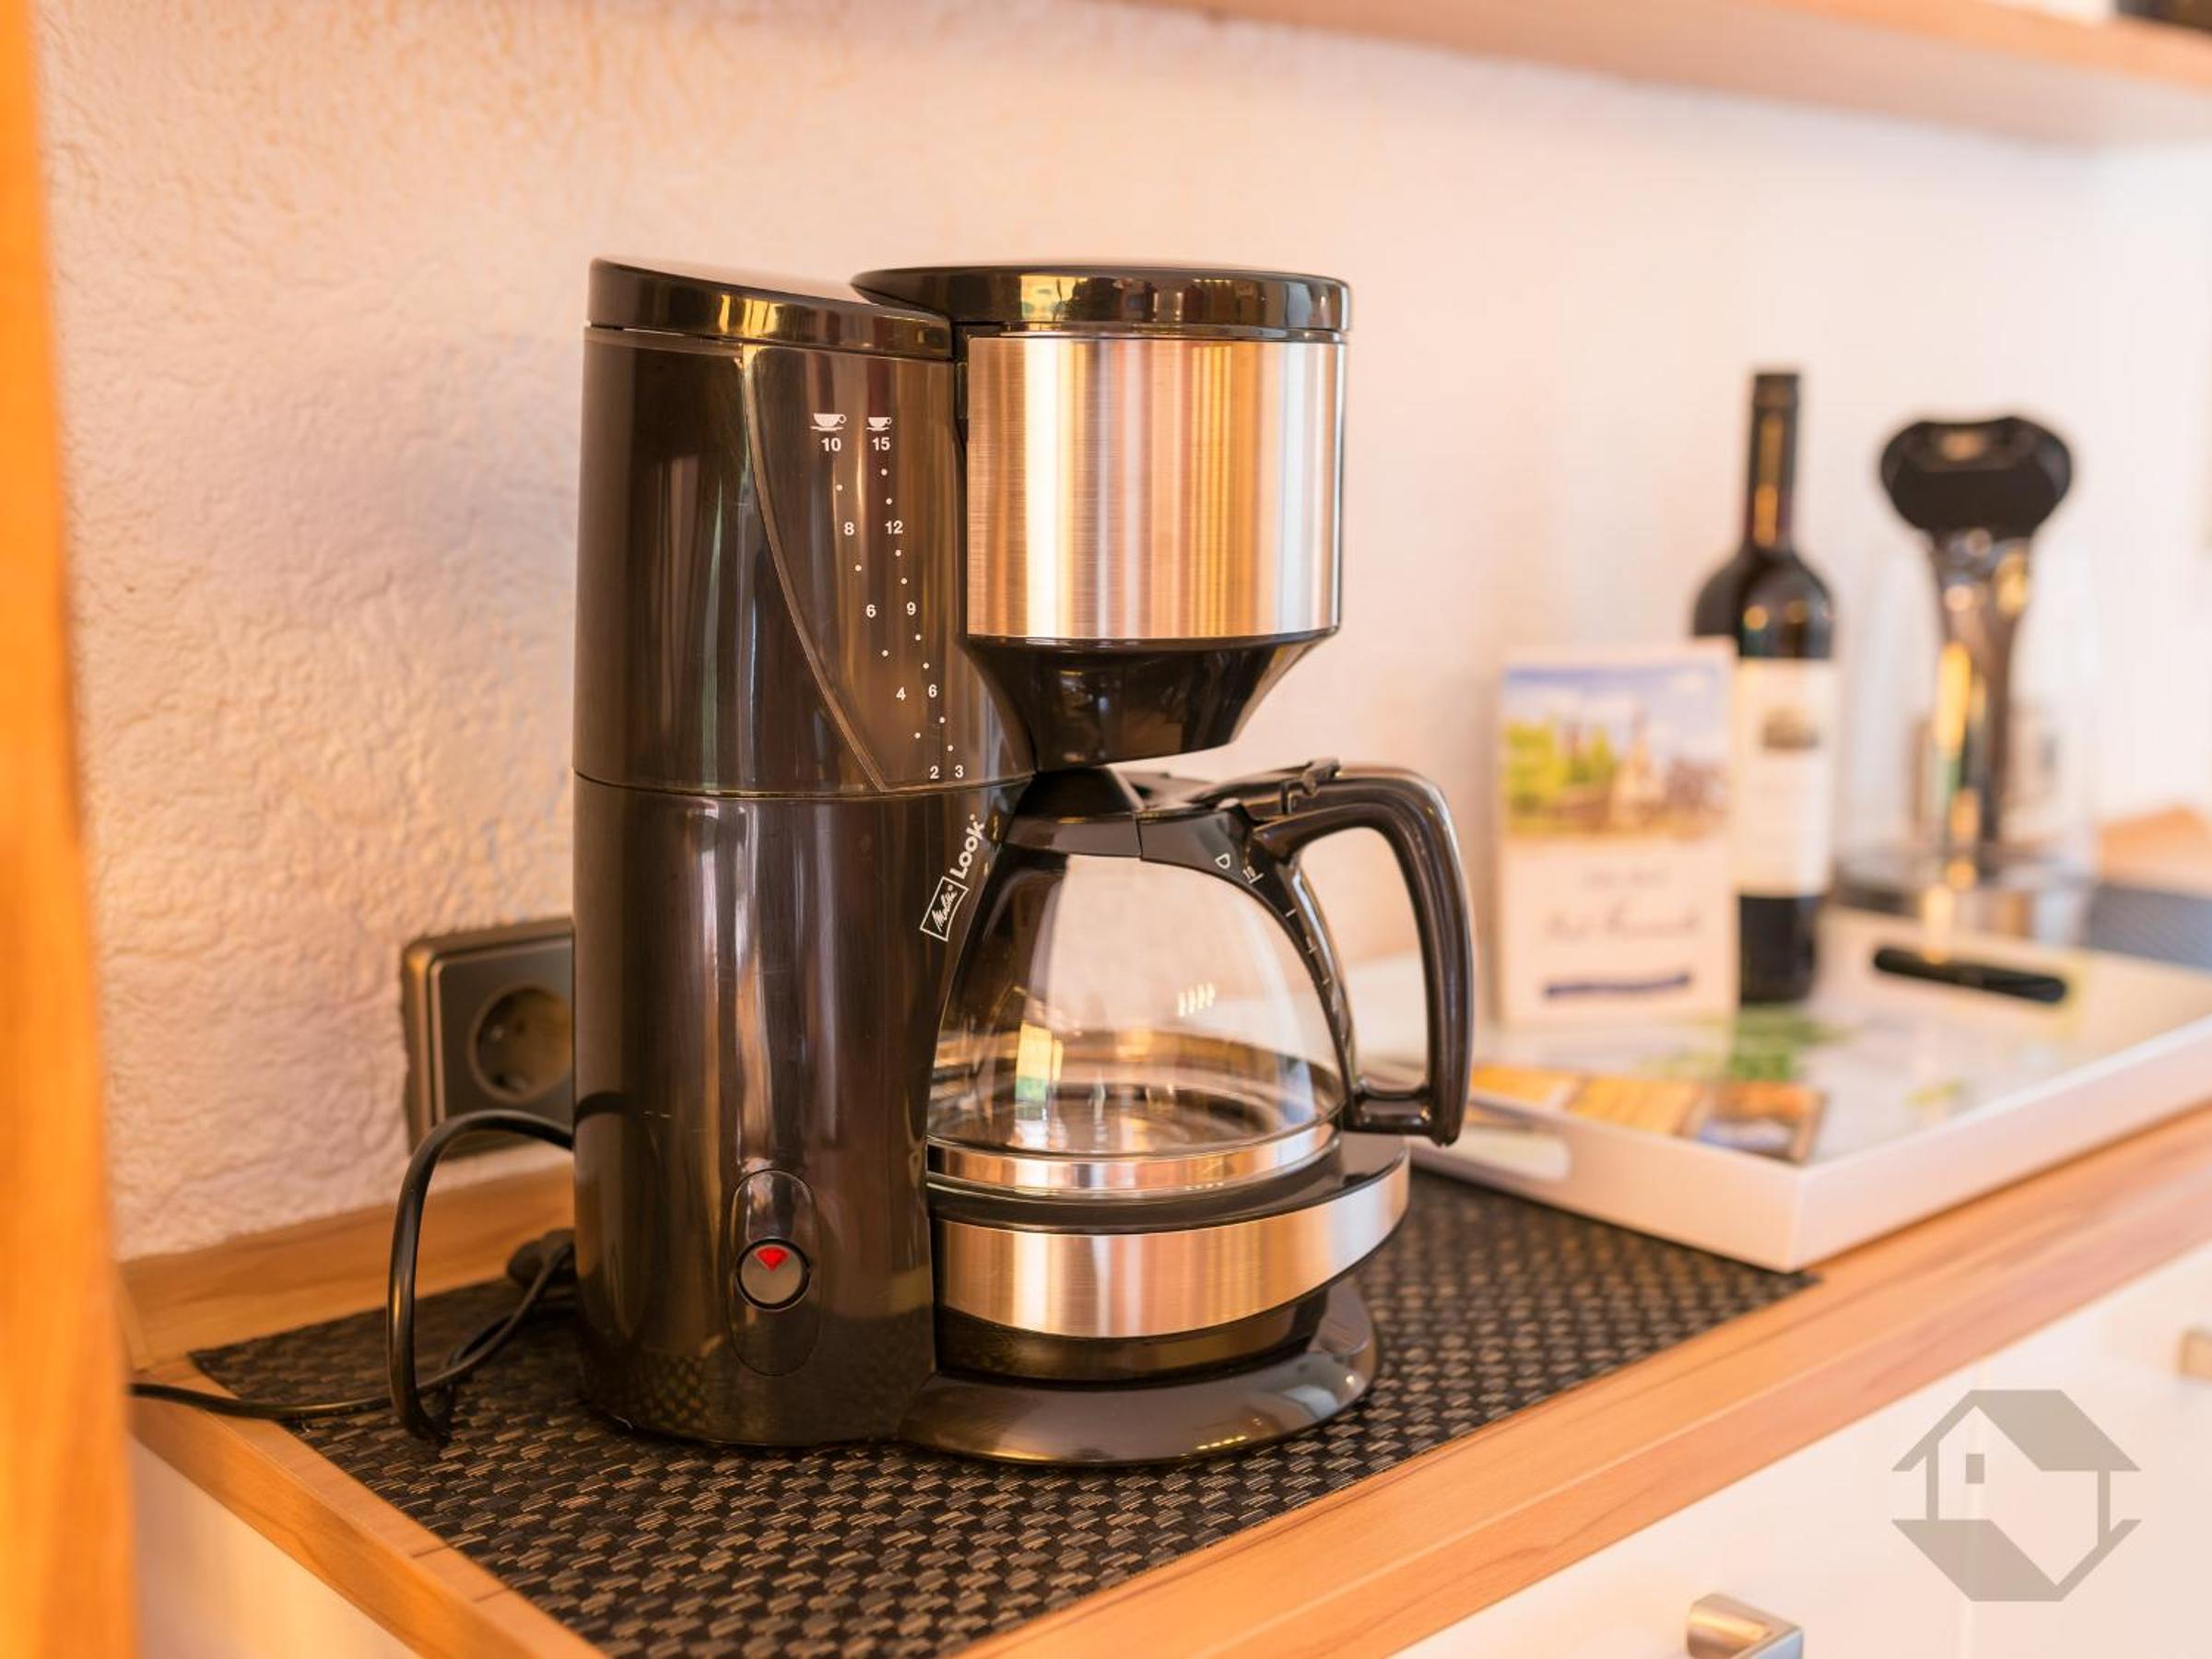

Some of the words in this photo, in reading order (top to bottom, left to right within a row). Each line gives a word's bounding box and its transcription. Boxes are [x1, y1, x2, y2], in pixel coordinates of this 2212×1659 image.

[821, 437, 841, 452] 10
[872, 437, 890, 451] 15
[843, 522, 855, 535] 8
[885, 520, 903, 535] 12
[865, 604, 877, 618] 6
[906, 601, 916, 616] 9
[896, 687, 906, 700] 4
[928, 684, 937, 698] 6
[930, 766, 940, 779] 2
[955, 764, 964, 778] 3
